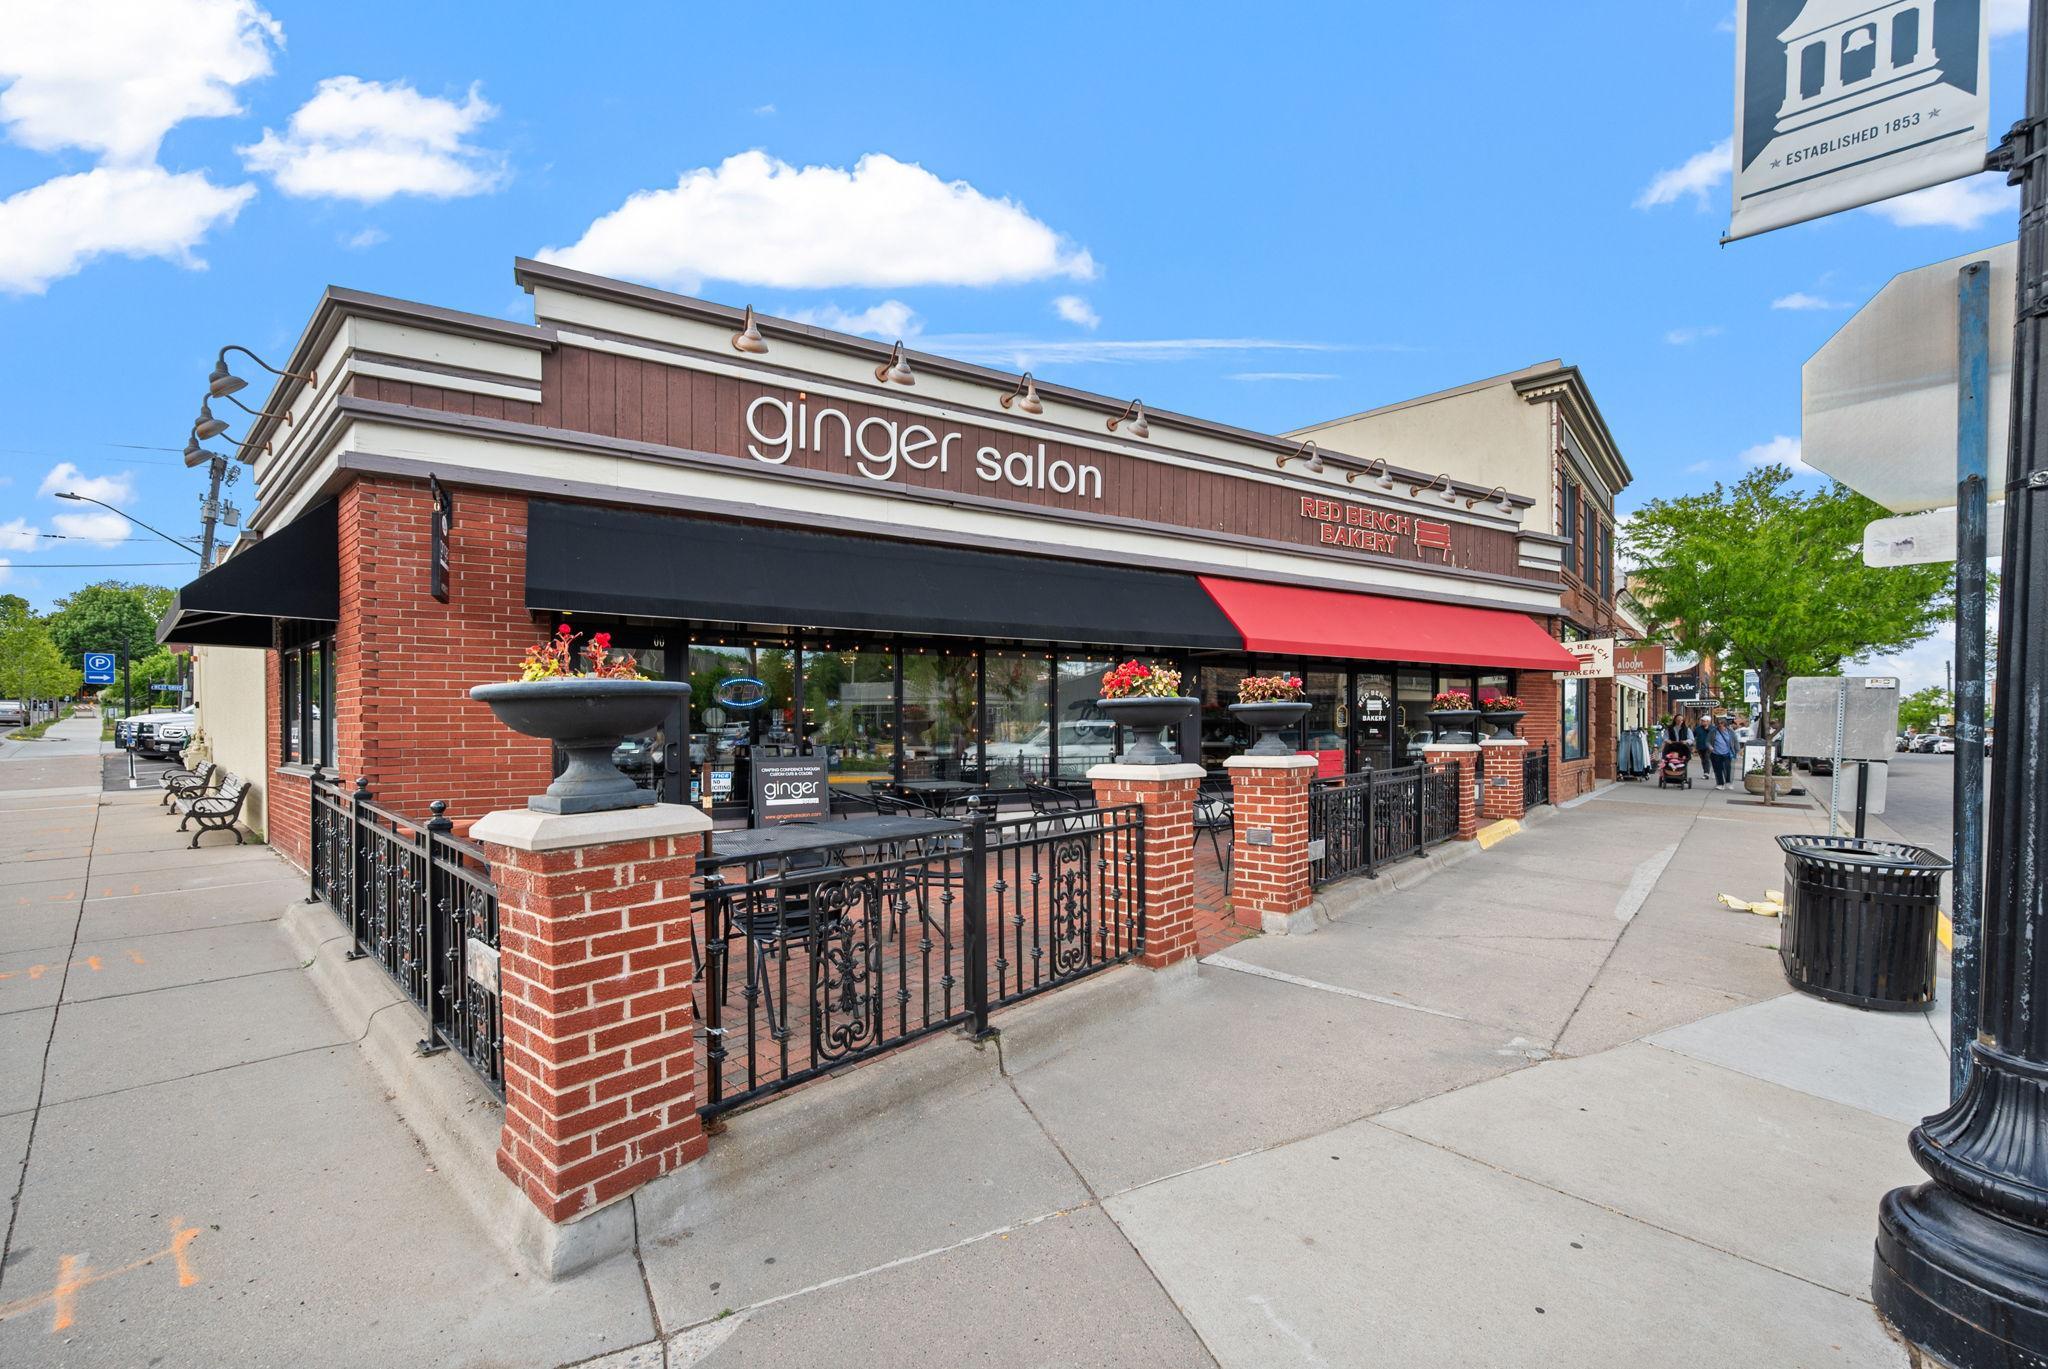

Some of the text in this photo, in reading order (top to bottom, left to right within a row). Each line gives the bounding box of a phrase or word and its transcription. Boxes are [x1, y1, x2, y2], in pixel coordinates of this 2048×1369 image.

[1786, 112, 1921, 166] ESTABLISHED 1853
[745, 392, 1102, 499] ginger salon
[1301, 496, 1411, 535] RED BENCH
[1320, 523, 1398, 554] BAKERY
[1577, 643, 1609, 660] BENCH
[95, 658, 105, 668] P
[1563, 669, 1602, 677] BAKERY
[1357, 689, 1391, 709] RED BENCH
[764, 780, 820, 800] ginger
